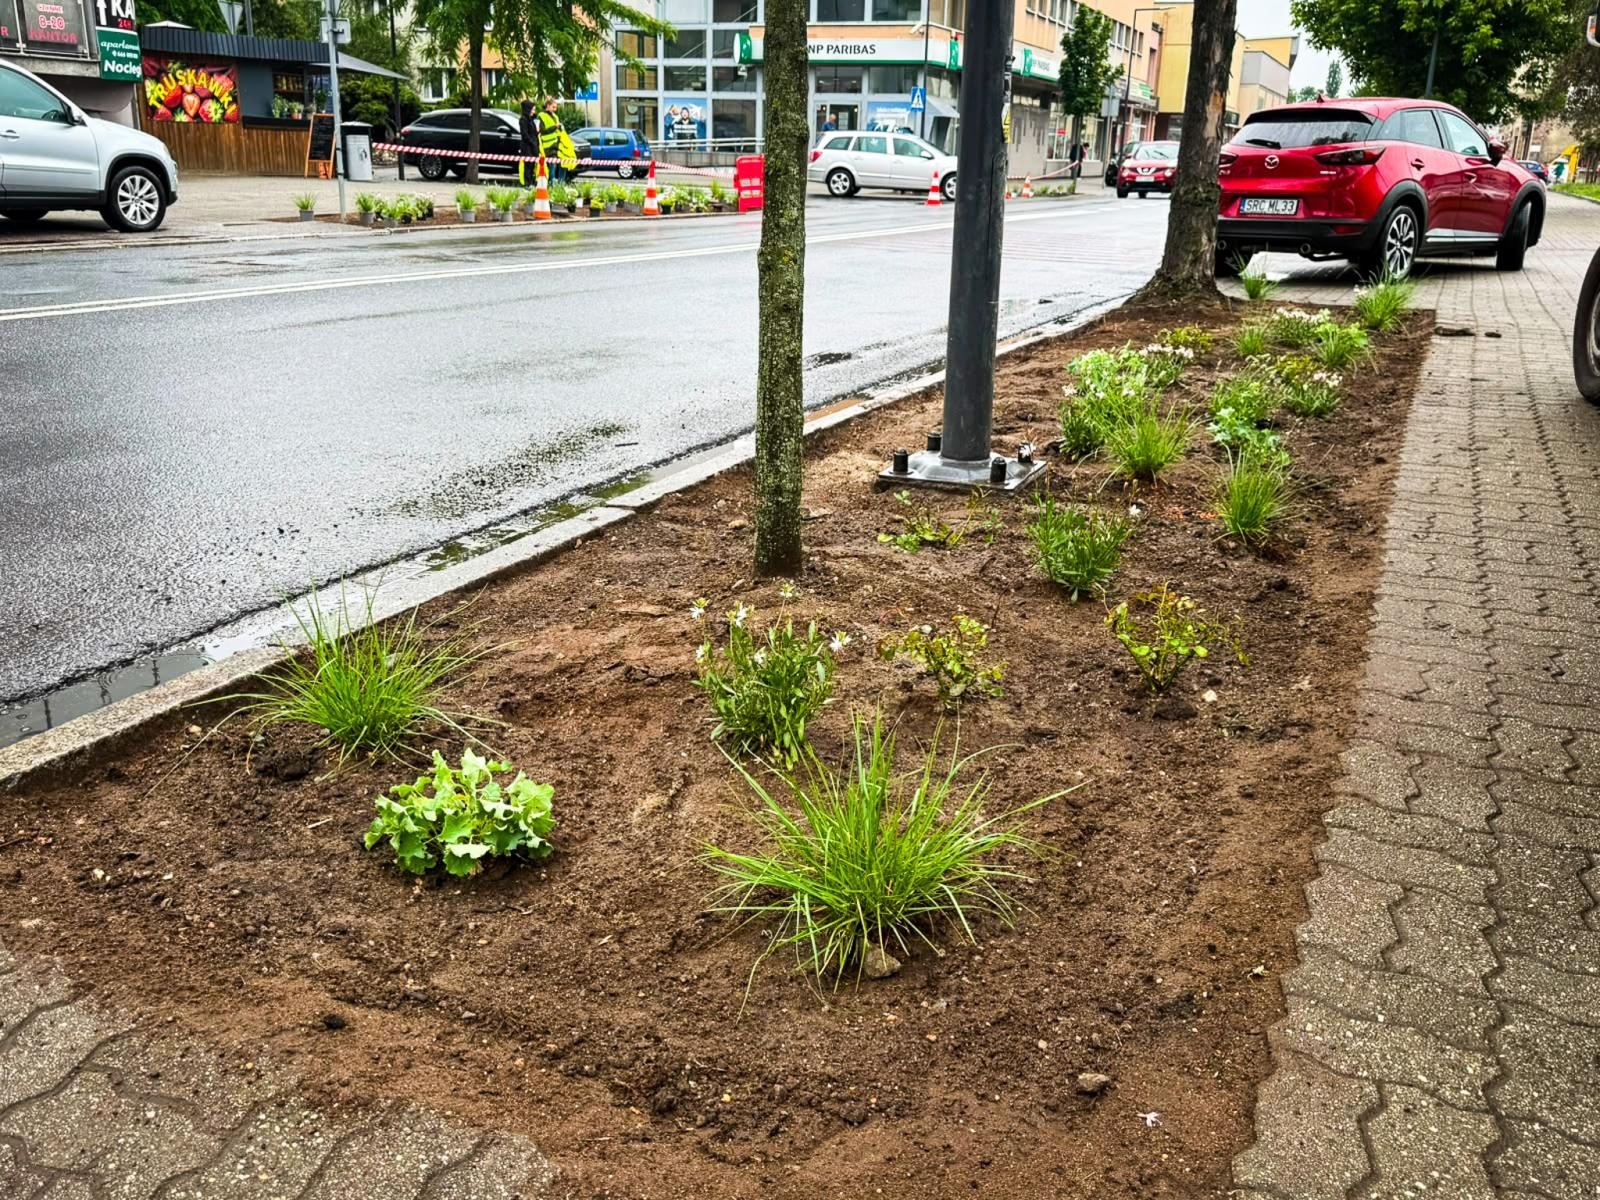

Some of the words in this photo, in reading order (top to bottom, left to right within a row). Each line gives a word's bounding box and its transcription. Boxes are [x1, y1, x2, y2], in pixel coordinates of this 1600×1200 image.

[30, 28, 78, 43] KANTOR
[808, 44, 824, 54] NP
[826, 44, 876, 54] PARIBAS
[149, 69, 237, 112] TRUSKAWKI
[1246, 199, 1266, 211] SRC
